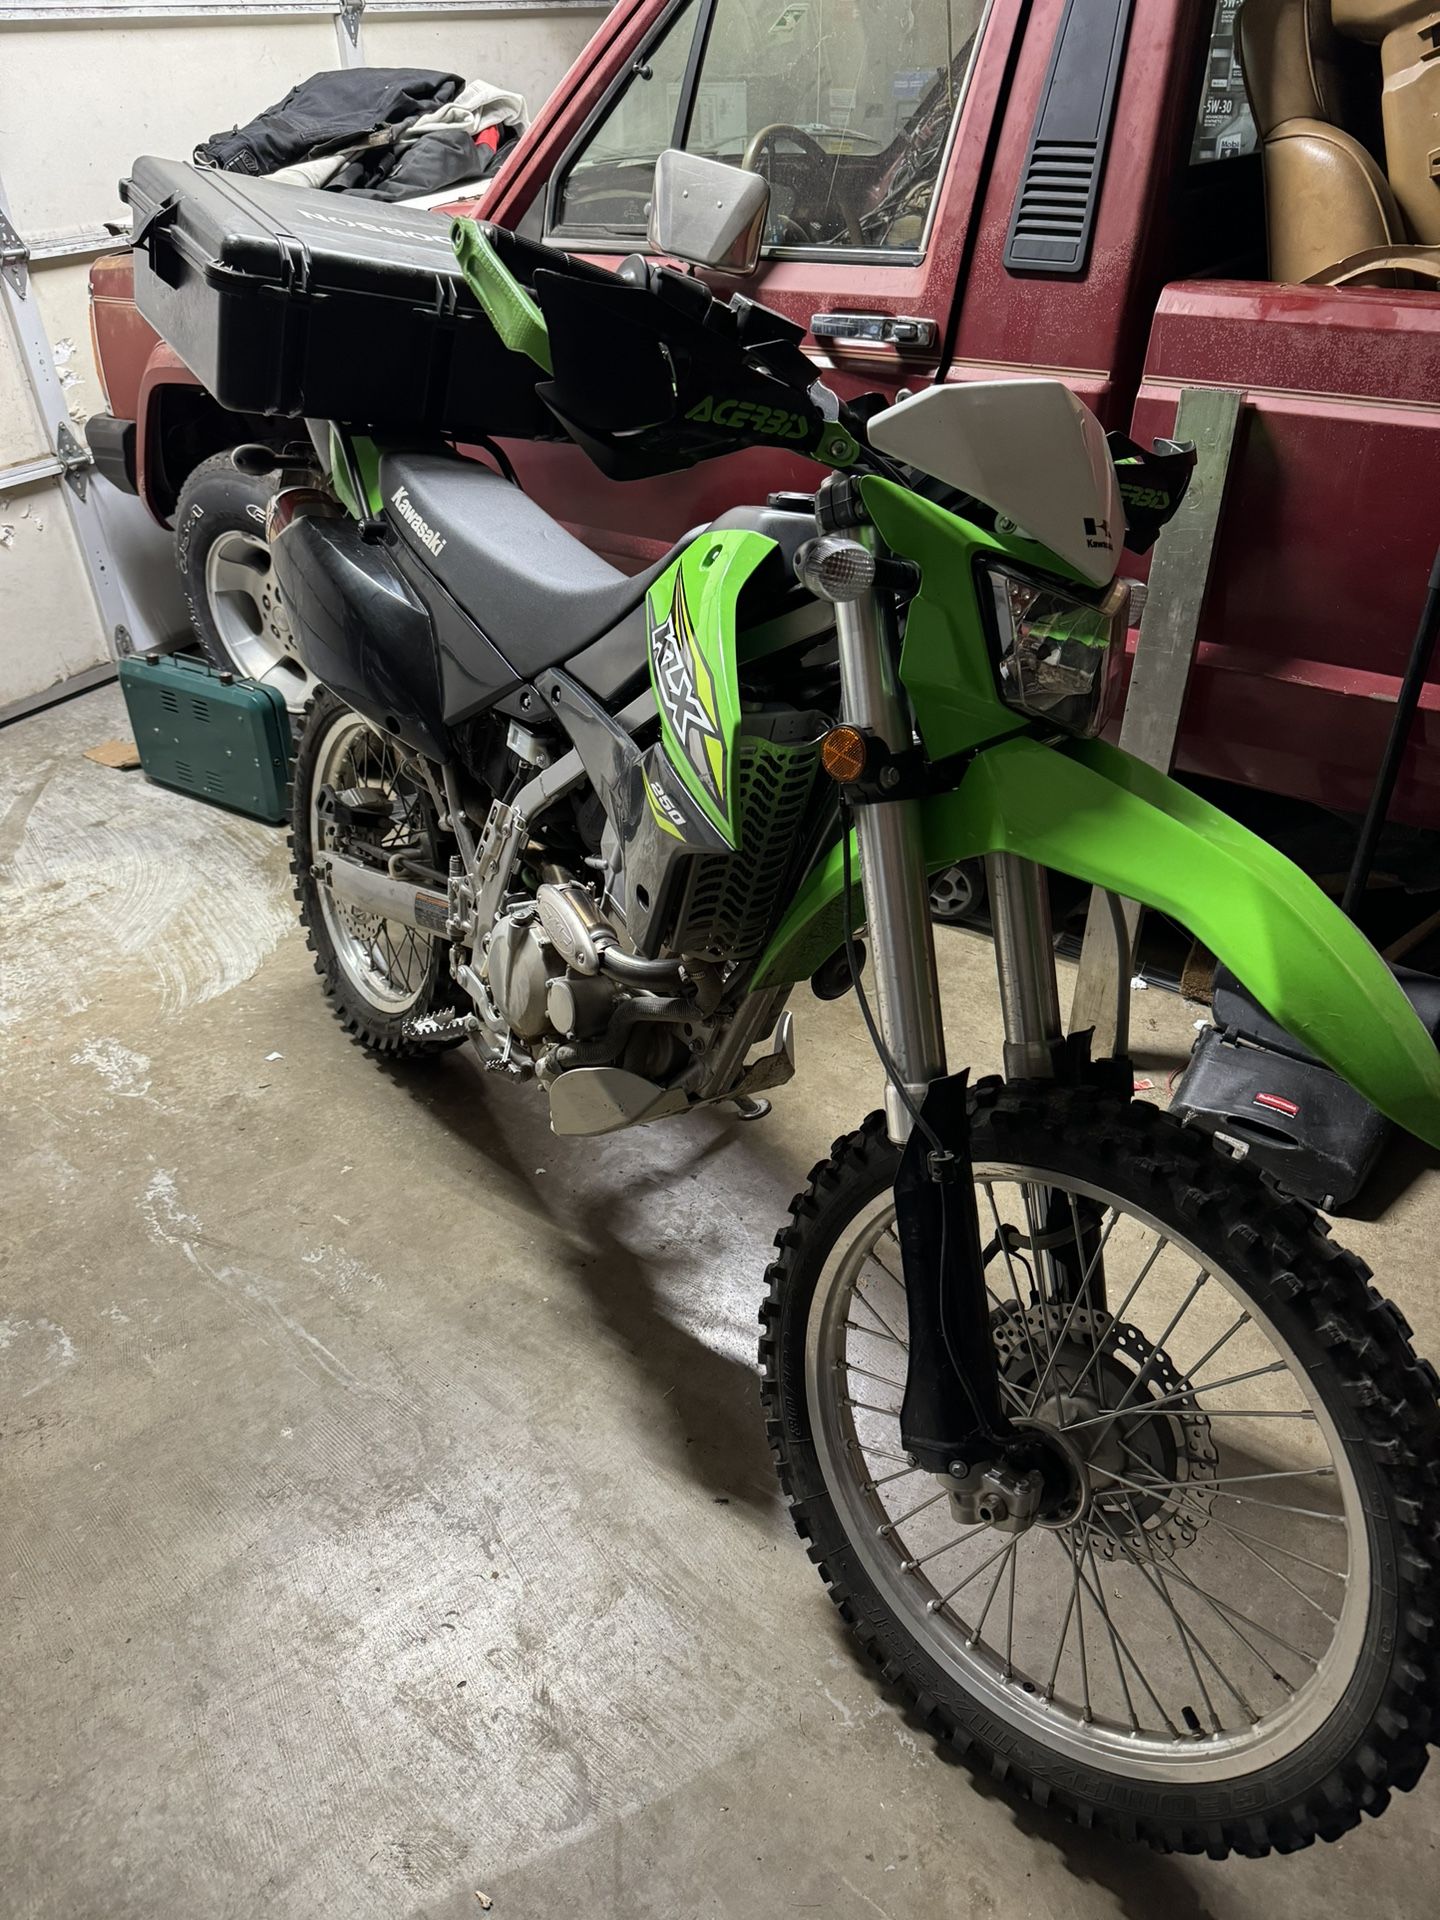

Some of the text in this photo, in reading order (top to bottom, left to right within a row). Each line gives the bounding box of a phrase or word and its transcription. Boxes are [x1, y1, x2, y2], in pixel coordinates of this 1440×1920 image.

[684, 395, 809, 439] ACERBIS
[391, 485, 448, 558] Kawasaki
[652, 612, 716, 746] KLX
[650, 782, 687, 825] 250
